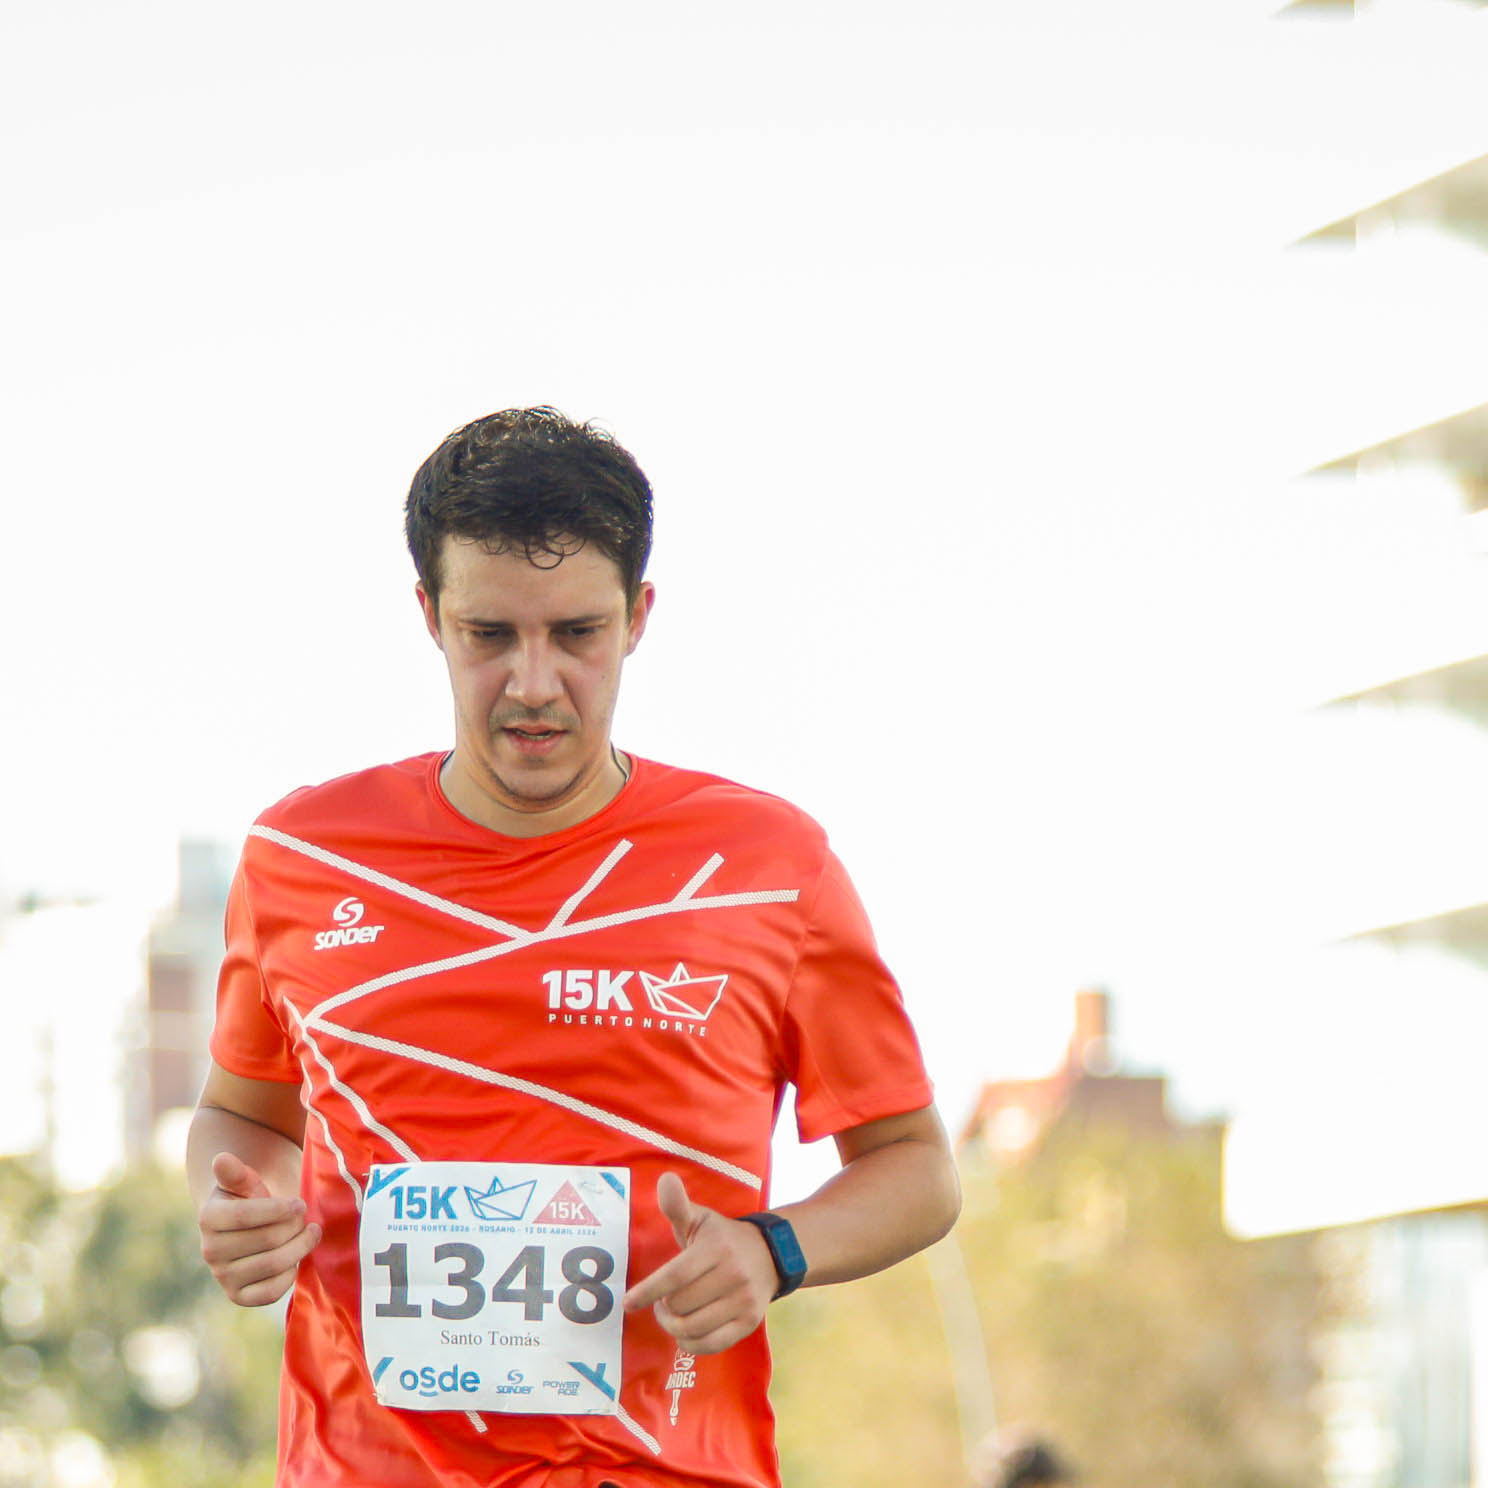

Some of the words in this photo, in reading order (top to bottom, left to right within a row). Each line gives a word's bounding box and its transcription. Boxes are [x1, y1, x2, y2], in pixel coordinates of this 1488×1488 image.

[542, 969, 635, 1011] 15K
[548, 1013, 633, 1027] PUERTO
[643, 1018, 707, 1037] NORTE
[389, 1186, 458, 1220] 15K
[549, 1201, 586, 1220] 15K
[374, 1242, 615, 1325] 1348
[440, 1329, 483, 1345] Santo
[488, 1330, 540, 1347] Tomás
[399, 1362, 481, 1393] osde
